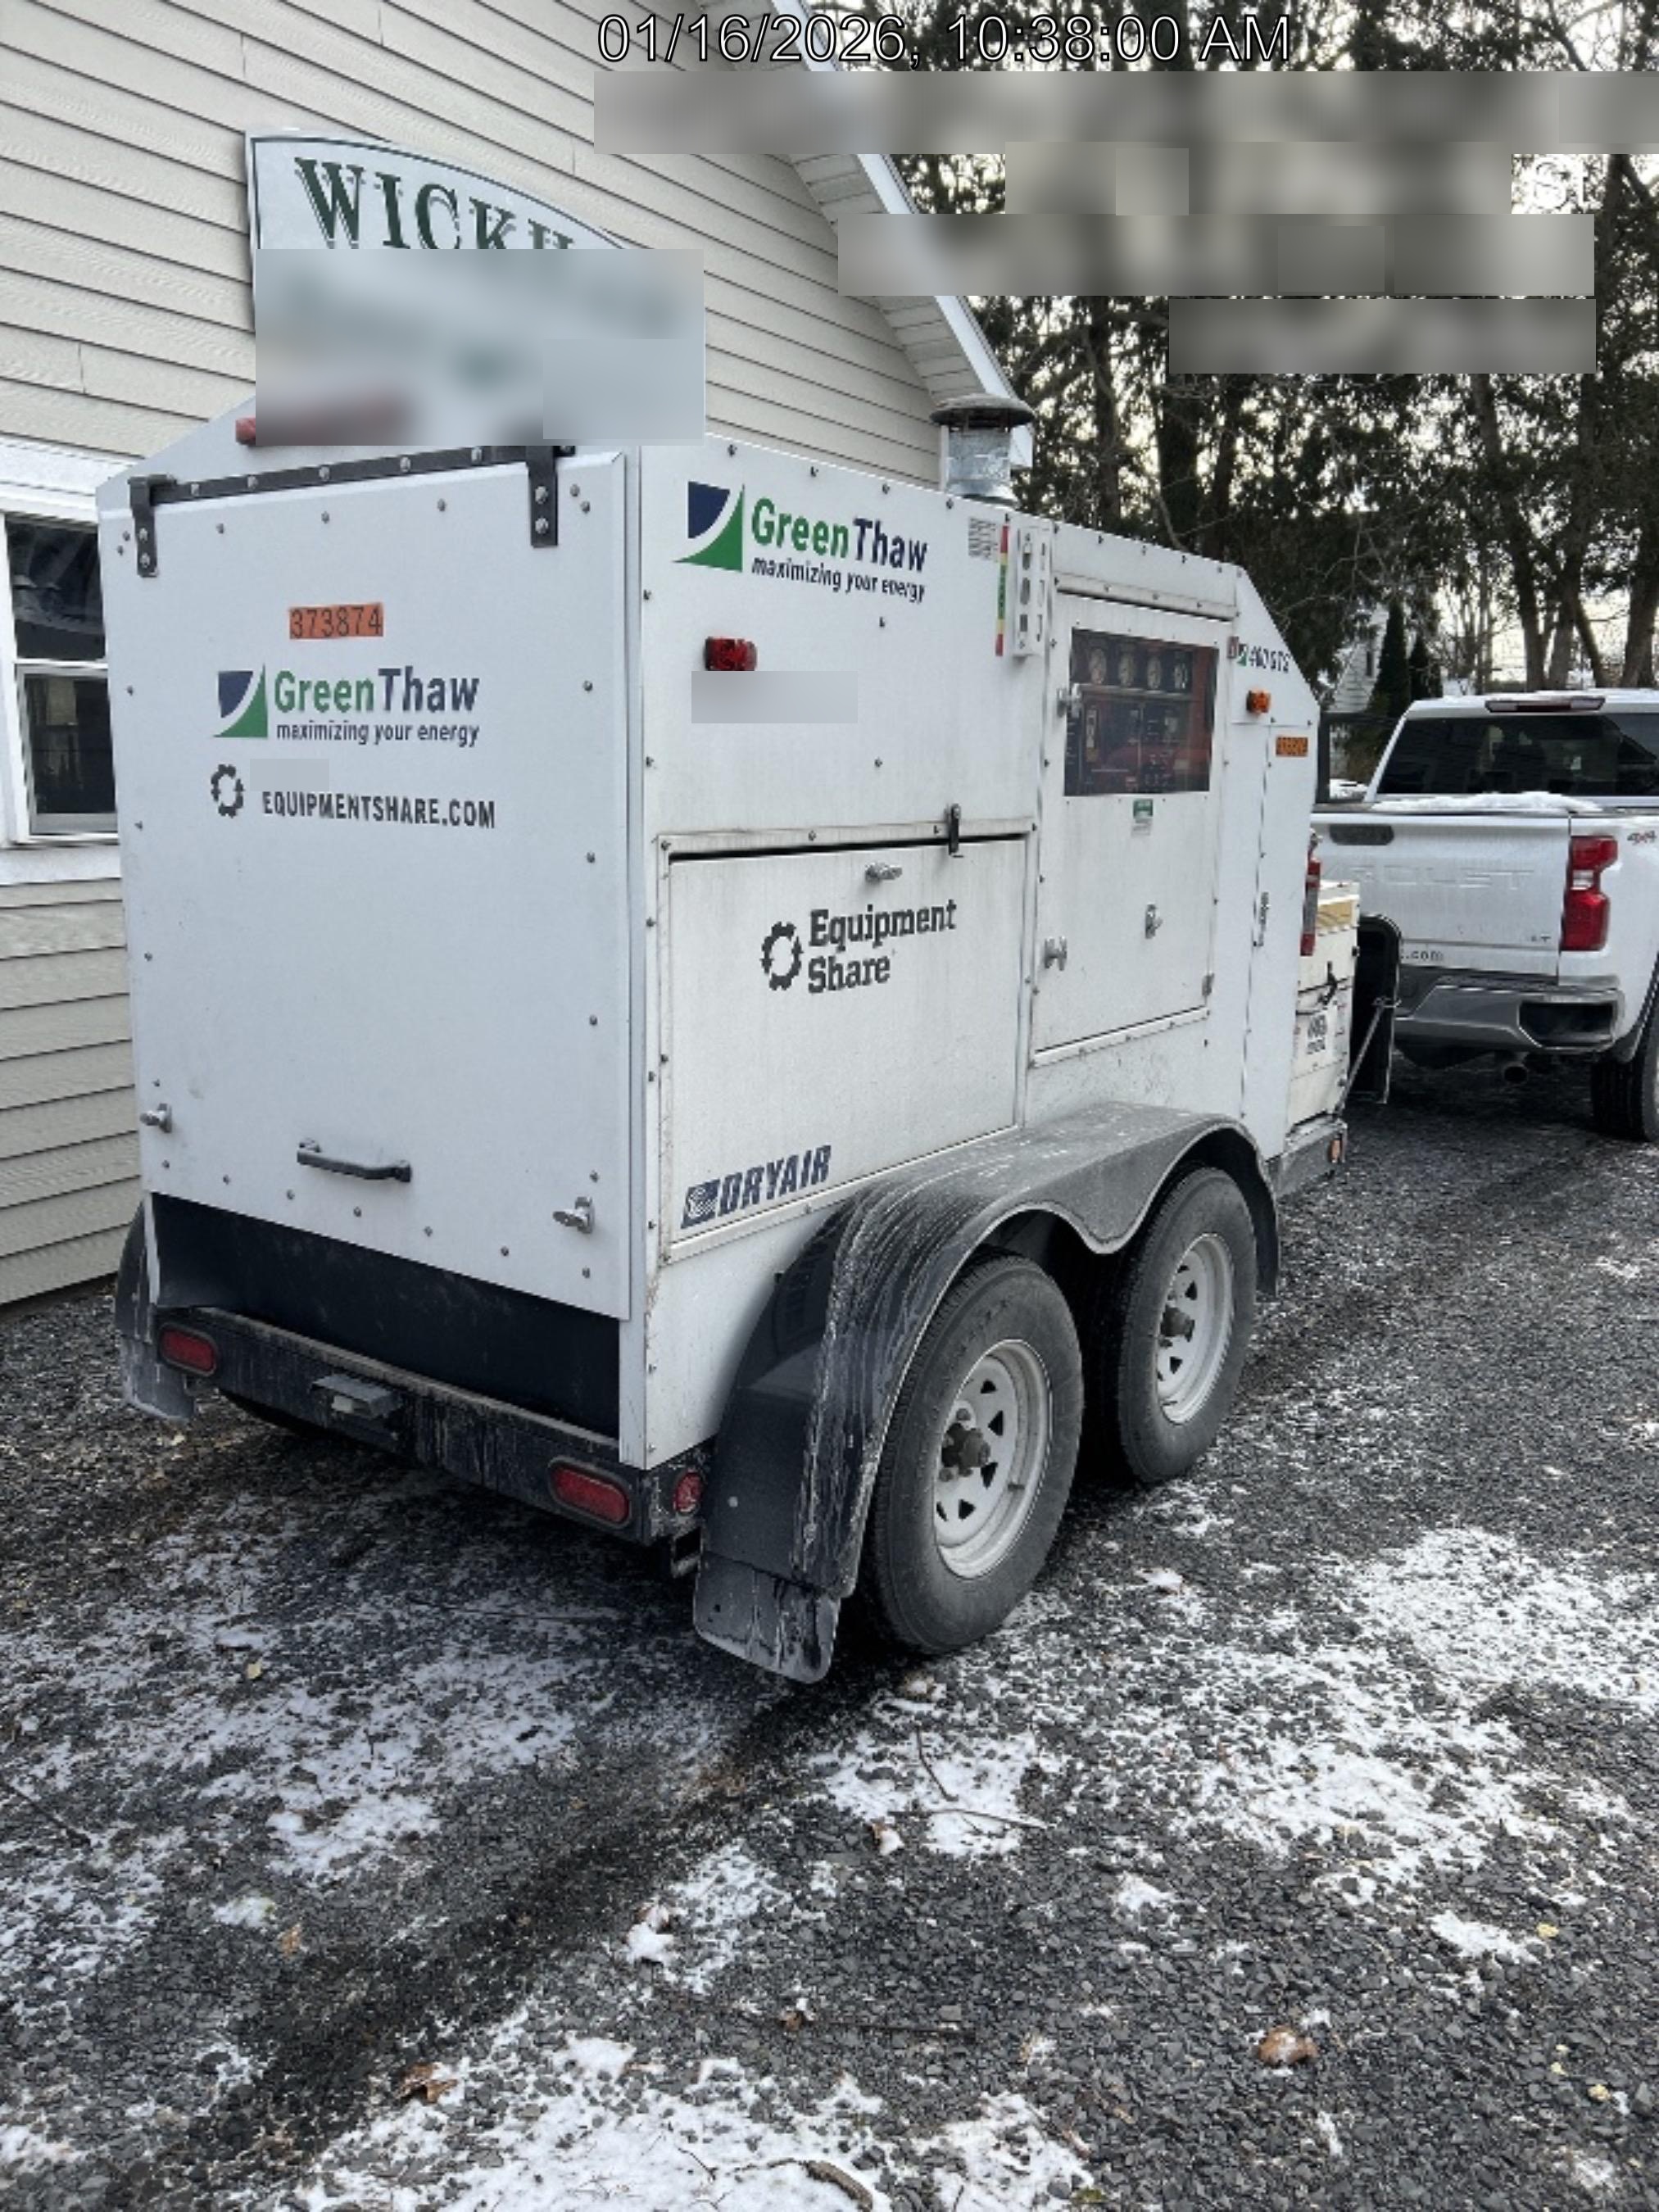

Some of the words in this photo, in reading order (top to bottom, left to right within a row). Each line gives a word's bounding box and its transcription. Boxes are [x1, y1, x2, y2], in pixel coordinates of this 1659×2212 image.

[751, 497, 928, 572] GreenThaw
[751, 557, 841, 592] maximizing
[845, 575, 877, 594] your
[881, 581, 925, 604] energy
[291, 605, 383, 638] 373874
[274, 665, 480, 714] GreenThaw
[277, 720, 369, 745] maximizing
[374, 724, 412, 746] your
[418, 724, 480, 747] energy
[262, 791, 496, 829] EQUIPMENTSHARE.COM
[808, 899, 957, 953] Equipment
[808, 955, 891, 994] Share
[718, 1145, 832, 1217] DRYAIR
